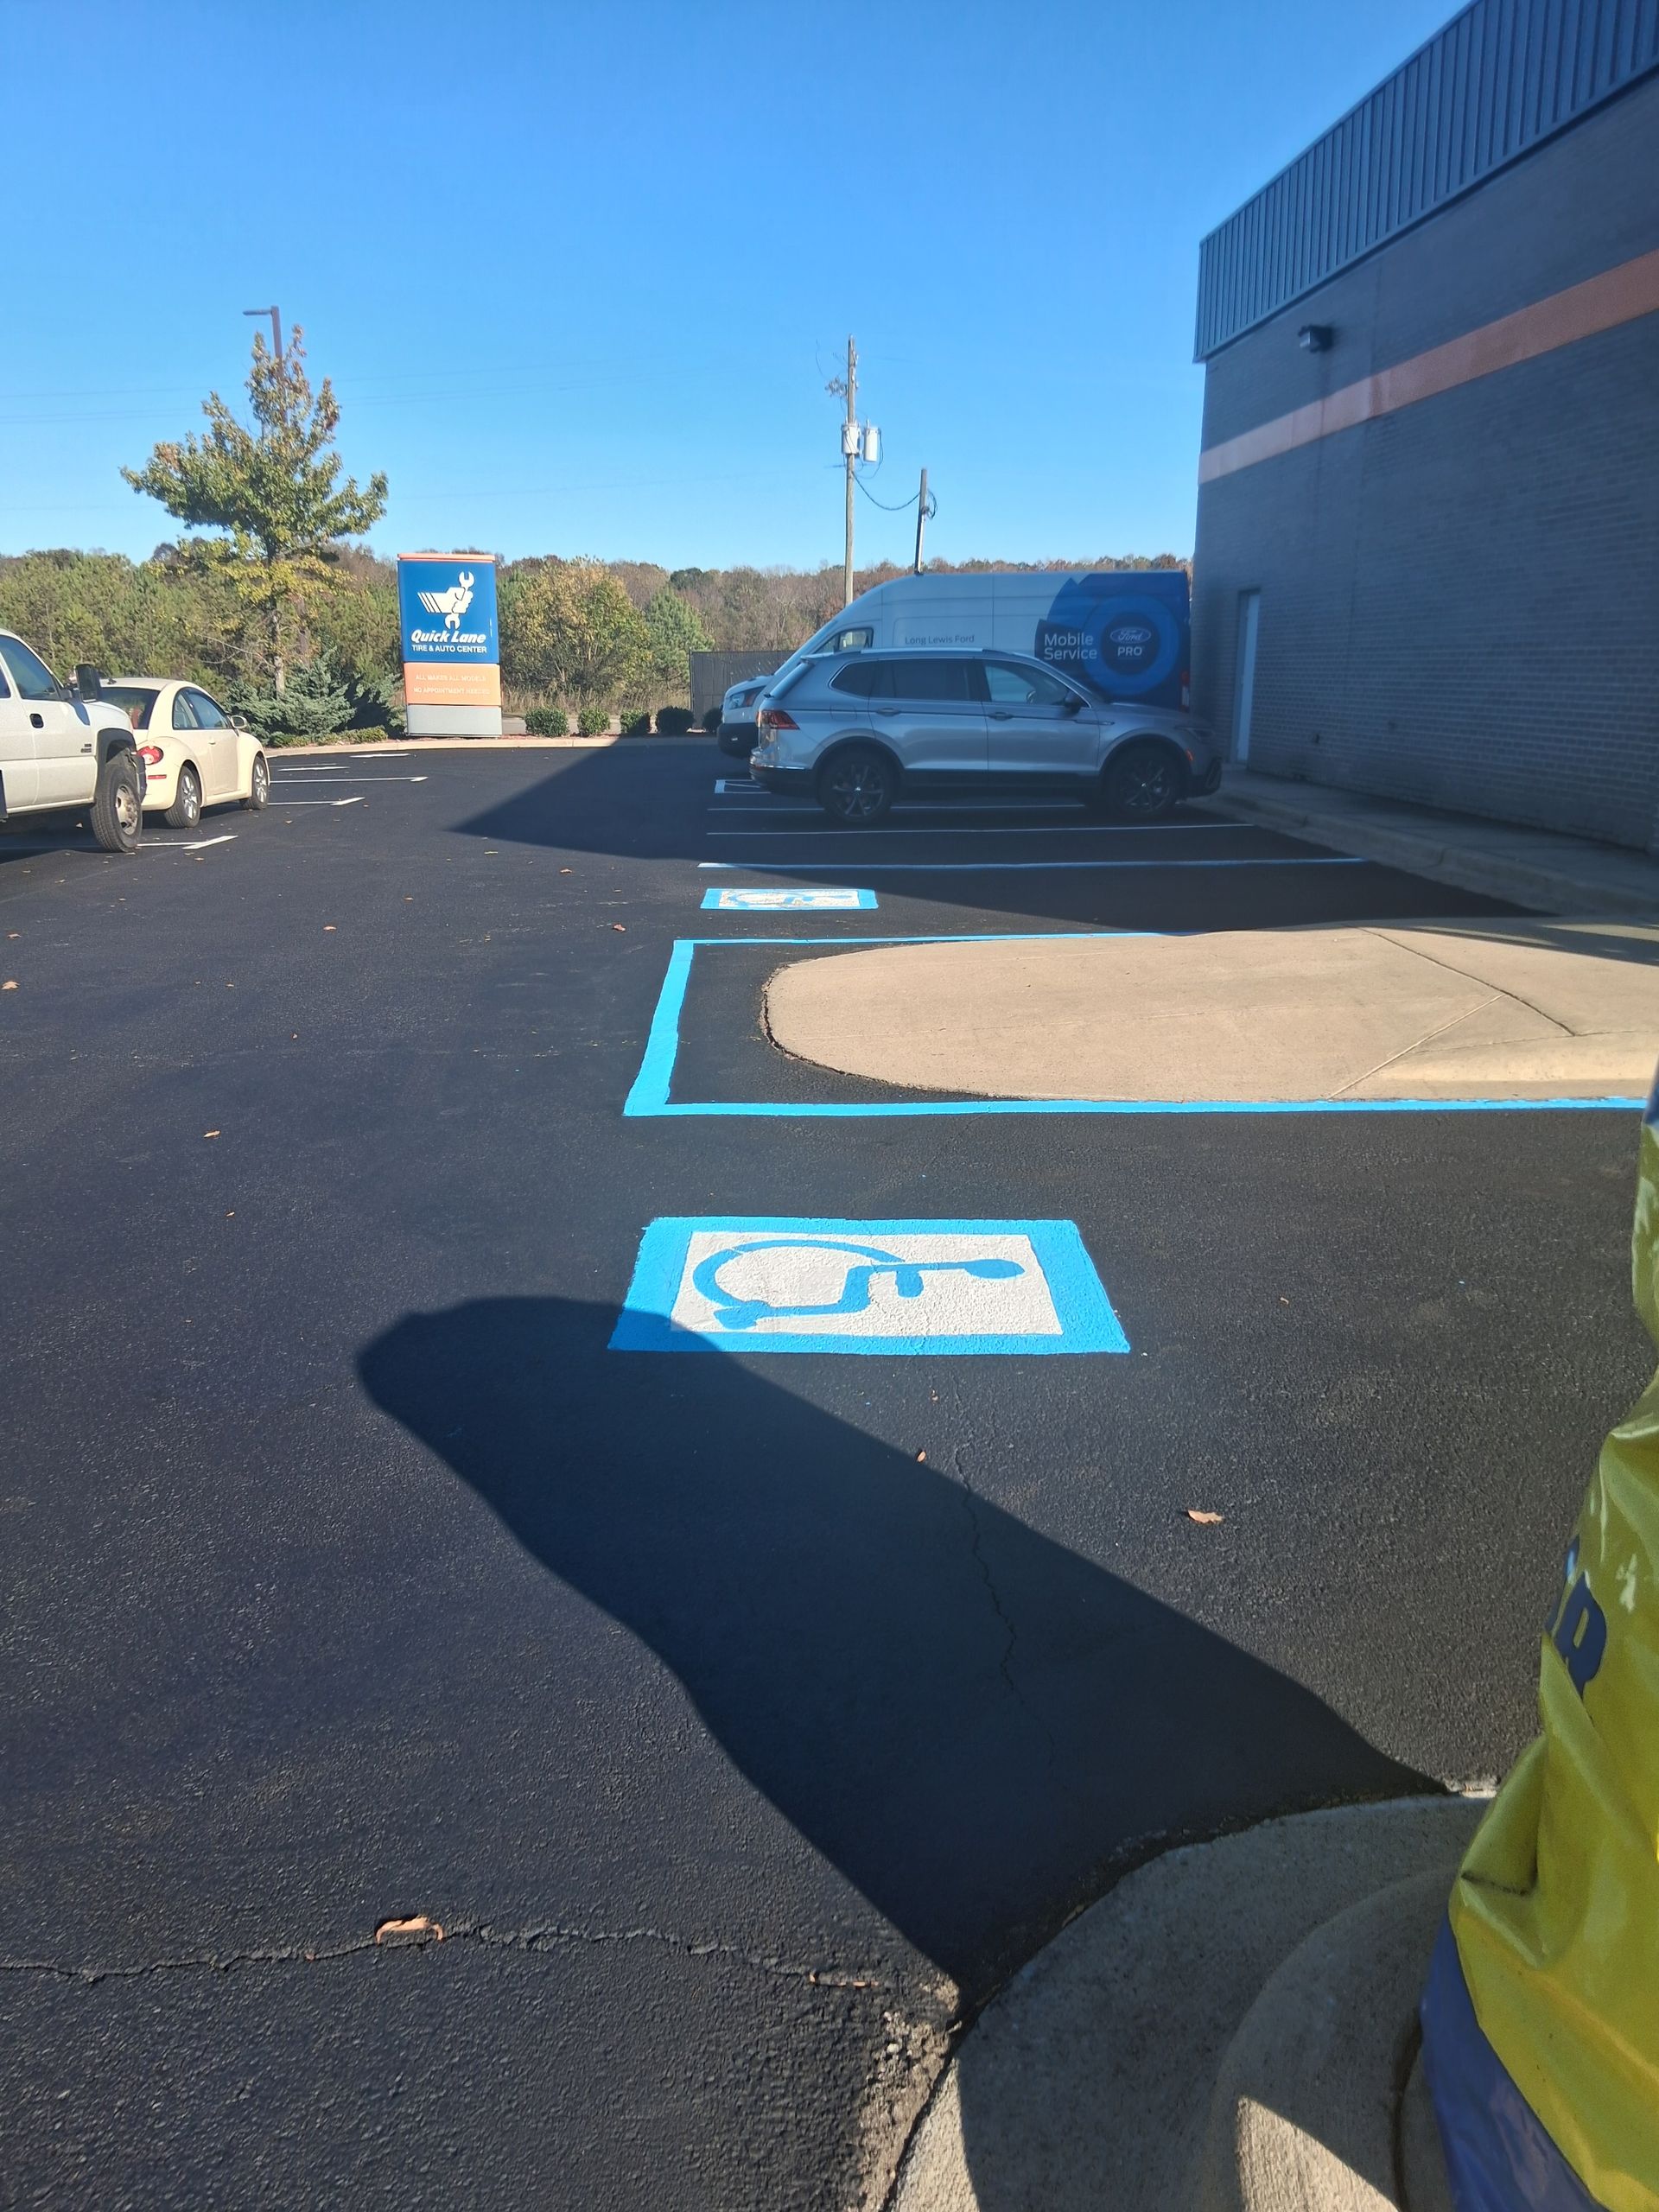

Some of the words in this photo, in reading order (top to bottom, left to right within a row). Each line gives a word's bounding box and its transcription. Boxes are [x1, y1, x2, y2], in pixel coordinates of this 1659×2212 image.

[411, 629, 450, 643] Quick
[451, 631, 486, 644] Lane
[905, 636, 927, 646] Long
[954, 634, 975, 644] Ford
[1044, 632, 1094, 646] Mobile
[1118, 630, 1143, 642] Ford
[1044, 647, 1097, 660] Service
[1117, 646, 1142, 657] PRO
